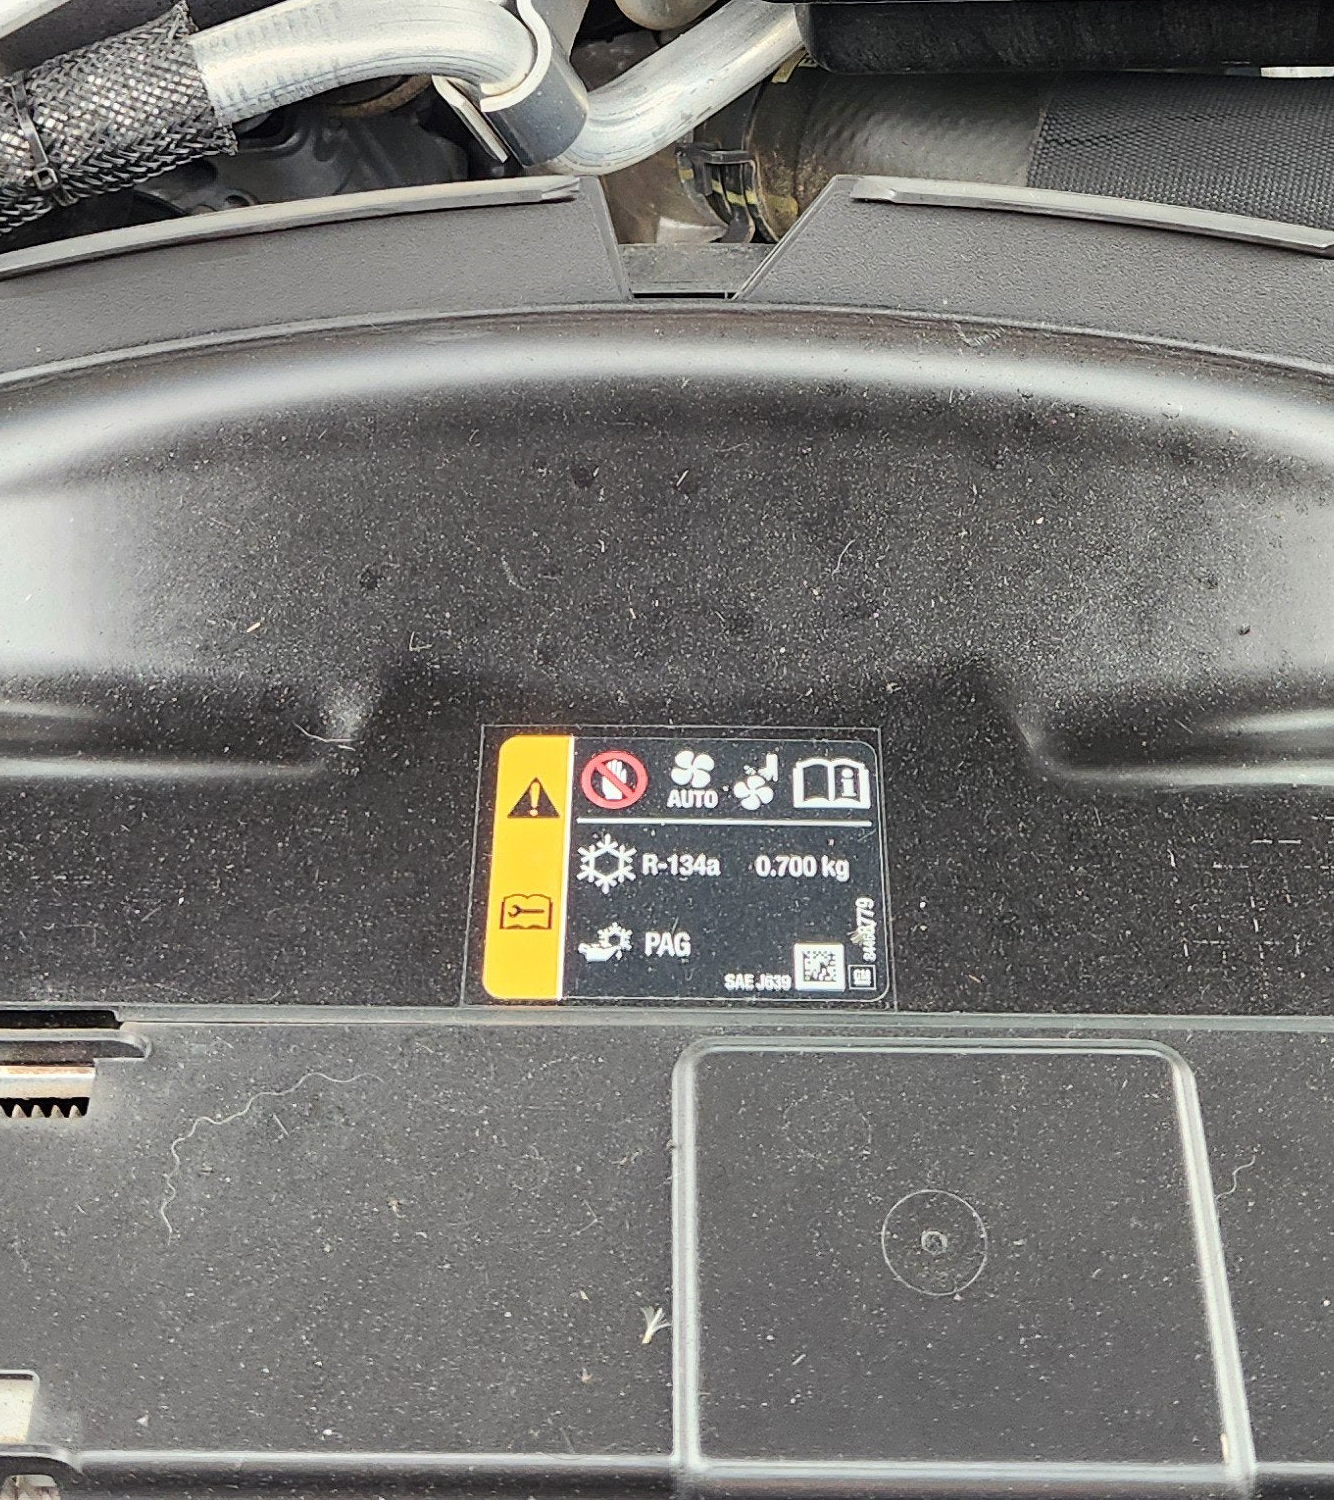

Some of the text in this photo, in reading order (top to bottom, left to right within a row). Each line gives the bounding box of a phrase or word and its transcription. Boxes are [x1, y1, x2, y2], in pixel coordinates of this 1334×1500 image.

[666, 789, 719, 809] AUTO
[642, 854, 851, 882] R-134a 0.700 kg
[644, 931, 692, 957] PAG
[724, 973, 792, 991] SAE J639
